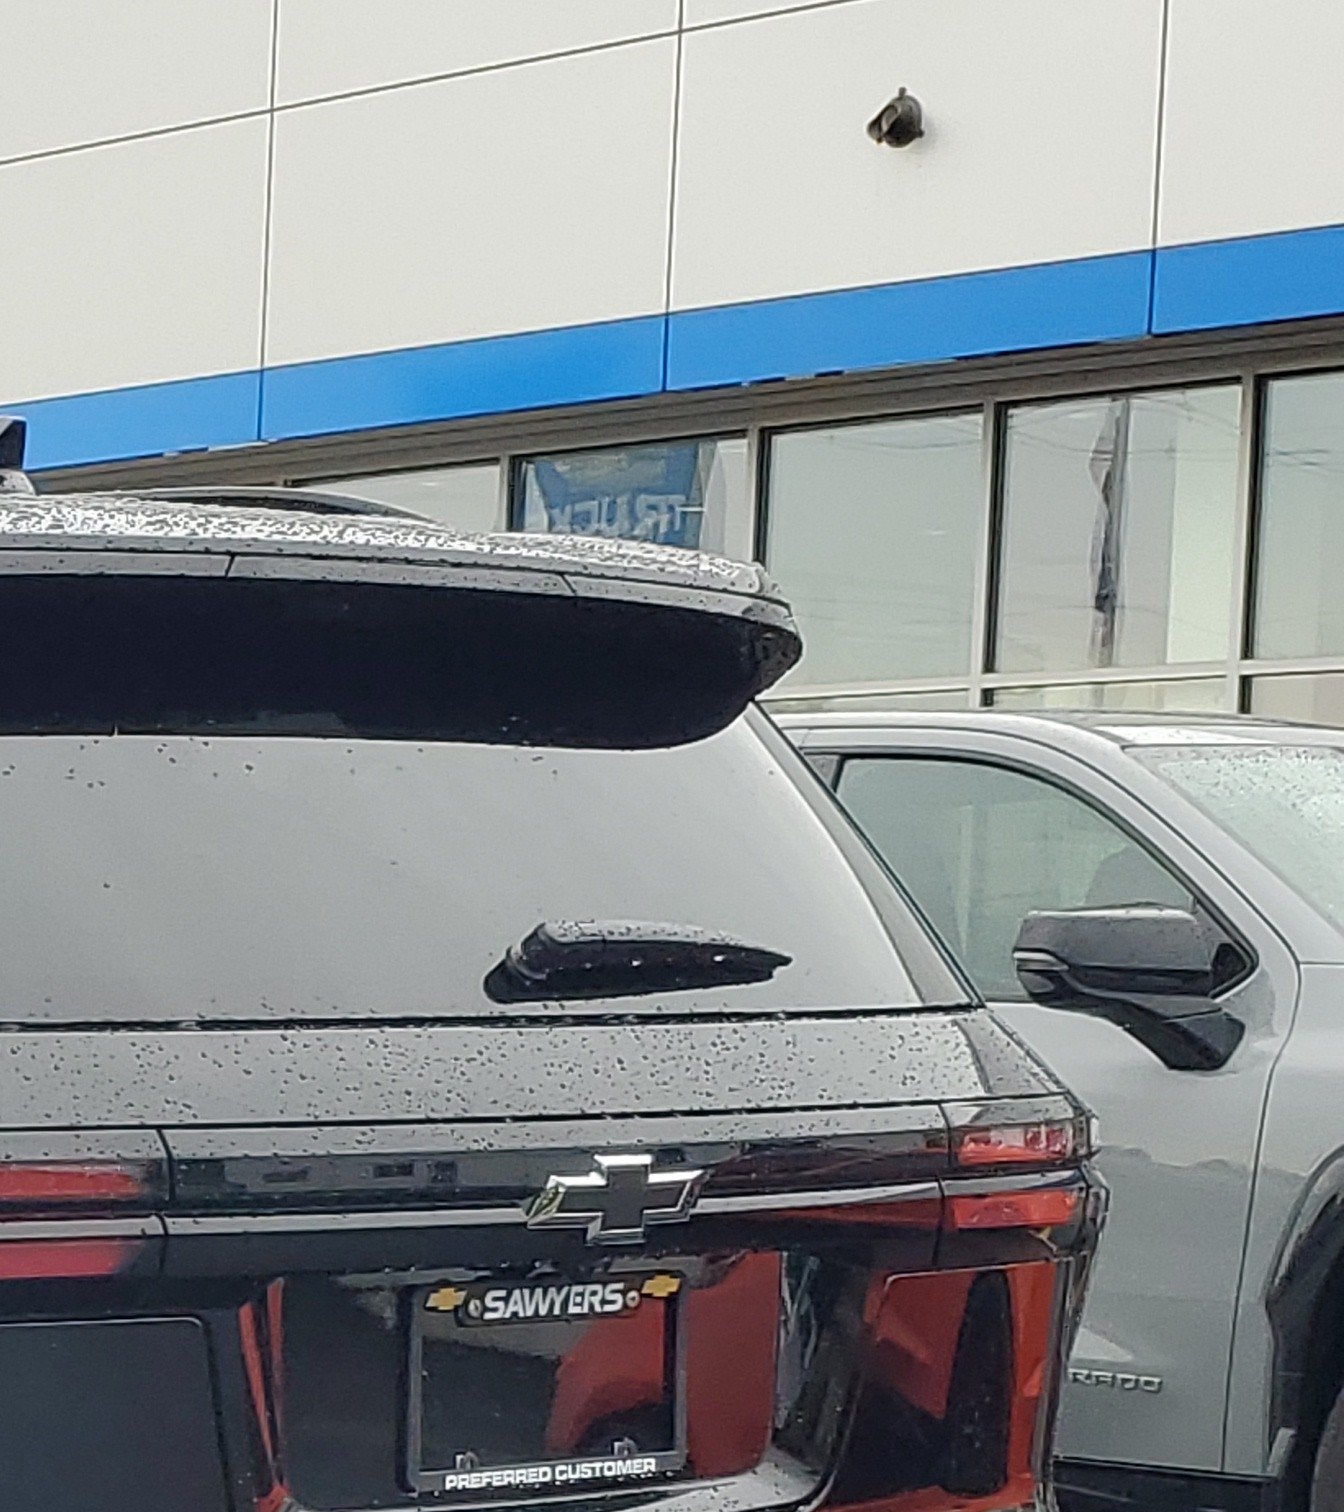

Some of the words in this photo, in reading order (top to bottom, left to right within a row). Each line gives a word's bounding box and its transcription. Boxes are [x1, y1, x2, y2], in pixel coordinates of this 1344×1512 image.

[482, 1282, 625, 1321] SAWYERS
[445, 1466, 553, 1490] PREFERRED
[554, 1458, 657, 1481] CUSTOMER
